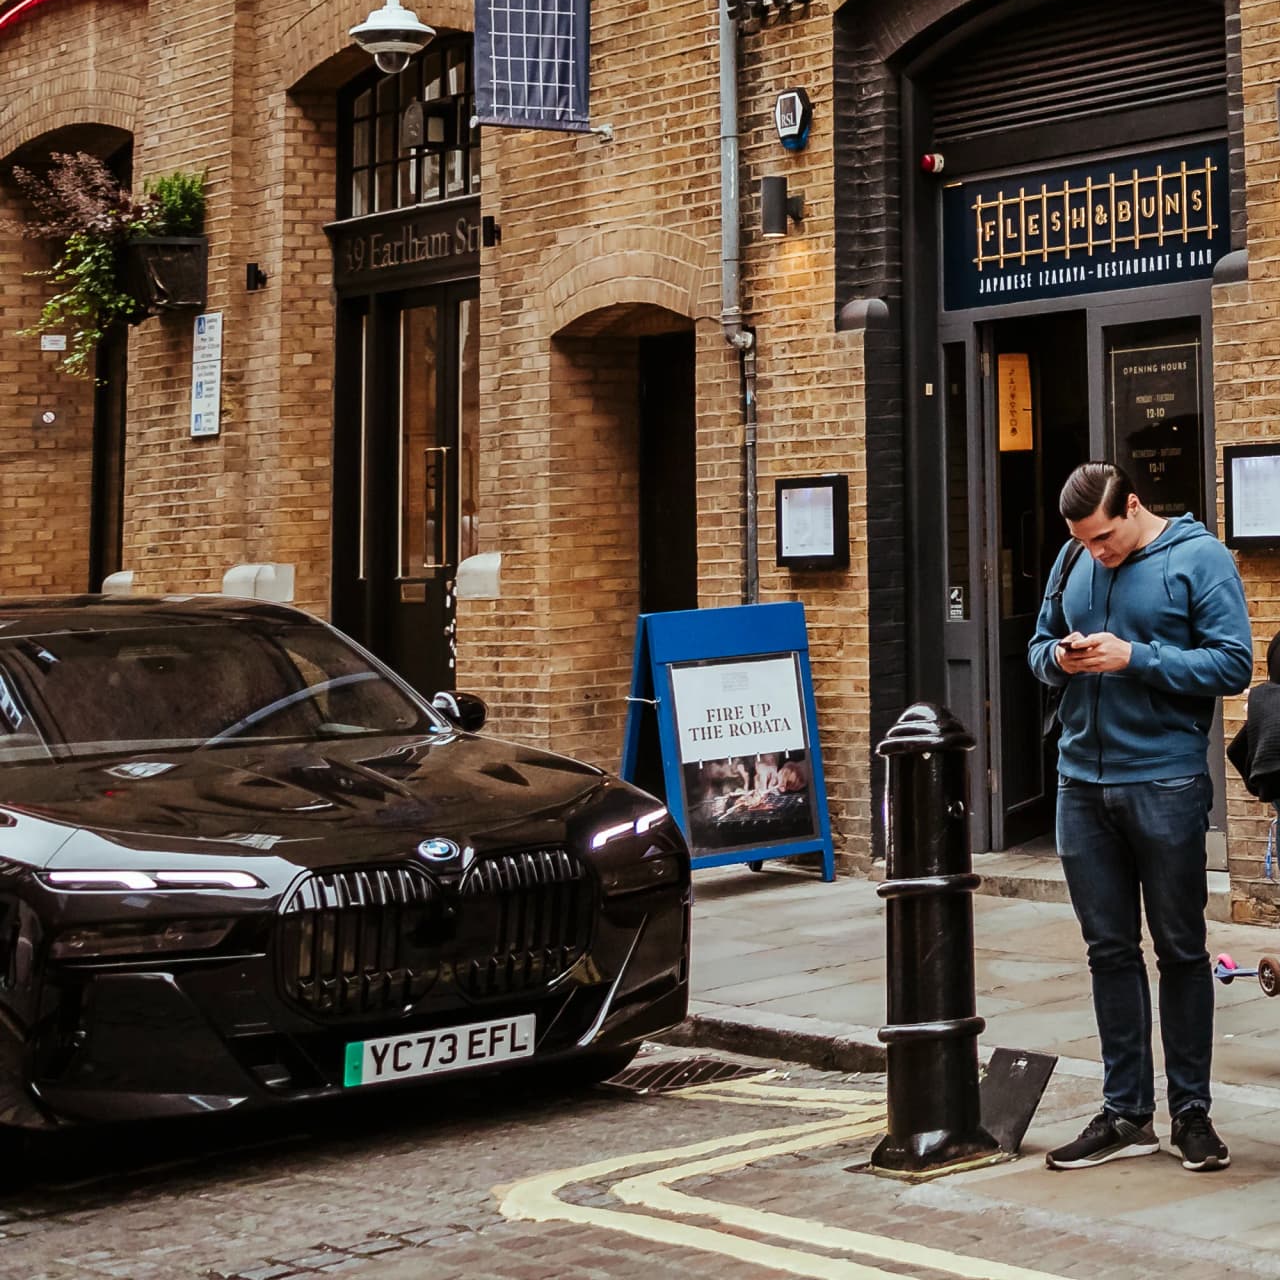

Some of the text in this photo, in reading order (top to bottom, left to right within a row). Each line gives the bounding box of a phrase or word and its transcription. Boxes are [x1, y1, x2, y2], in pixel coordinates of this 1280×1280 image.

[781, 111, 796, 126] RSL
[369, 224, 451, 269] Earlham
[979, 272, 1032, 294] JAPANESE
[1190, 248, 1212, 266] BAR
[1123, 361, 1187, 375] OPENING HOURS
[706, 703, 771, 722] FIRE UP
[688, 717, 791, 741] THE ROBATA
[371, 1022, 528, 1076] YC73 EFL
